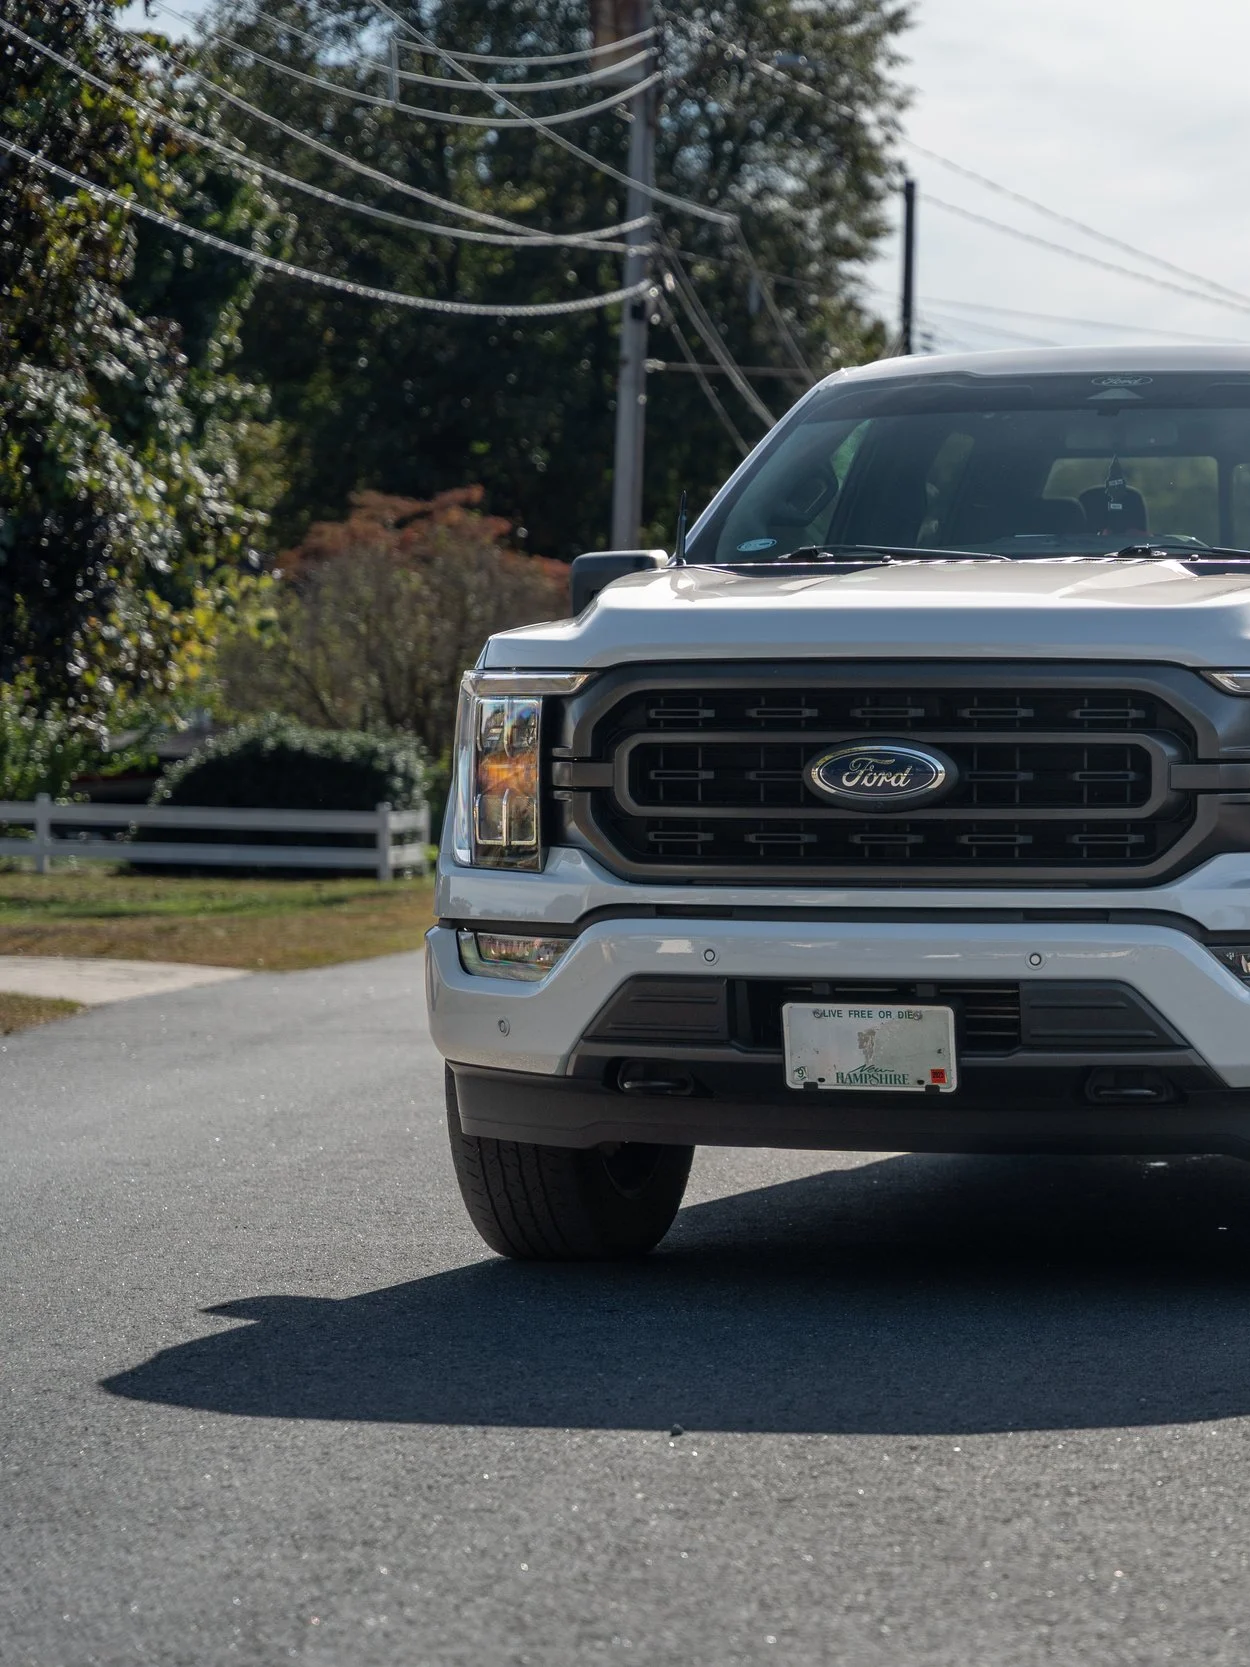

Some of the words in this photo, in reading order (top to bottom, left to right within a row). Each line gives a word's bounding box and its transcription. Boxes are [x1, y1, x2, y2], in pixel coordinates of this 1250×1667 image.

[841, 757, 913, 787] Ford
[823, 1009, 843, 1018] LIVE
[848, 1009, 873, 1019] FREE
[878, 1010, 892, 1019] OR
[897, 1010, 914, 1020] DIE
[848, 1063, 895, 1074] New
[835, 1072, 910, 1085] HAMPSHIRE
